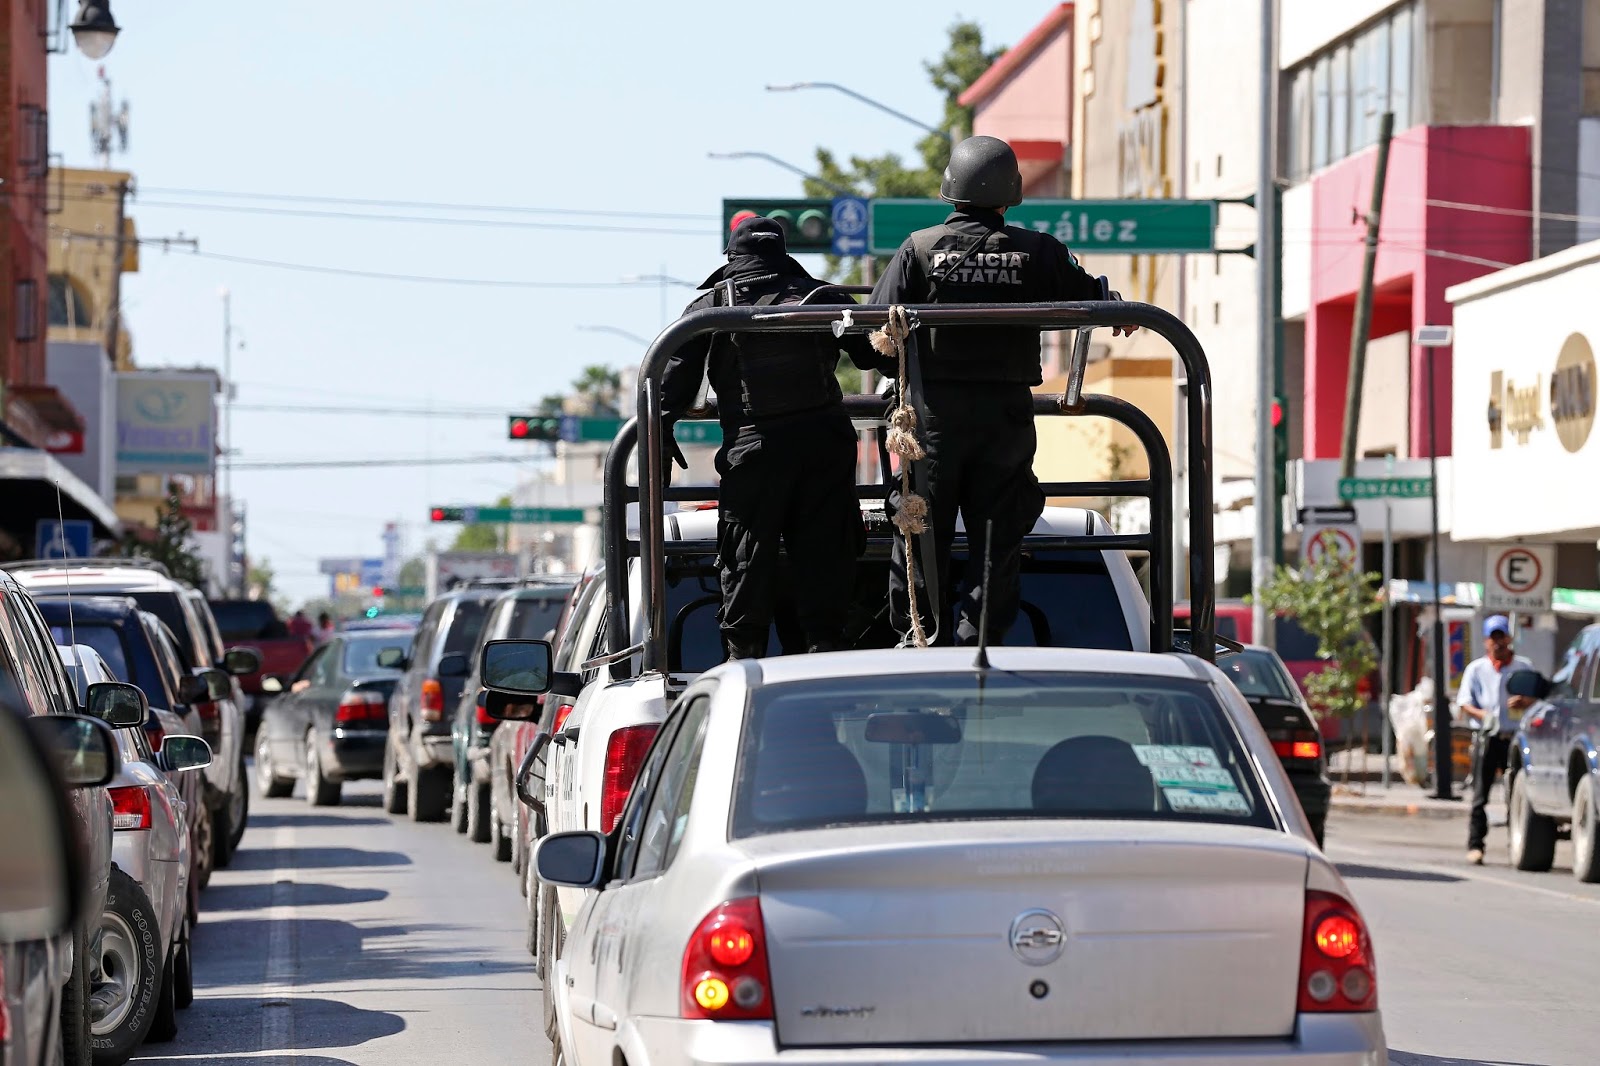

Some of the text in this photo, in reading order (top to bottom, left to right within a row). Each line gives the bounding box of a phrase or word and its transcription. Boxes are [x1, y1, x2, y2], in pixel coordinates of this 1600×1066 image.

[933, 252, 1023, 268] POLICIA
[1508, 556, 1529, 585] E
[128, 908, 156, 1032] GOODYEAR
